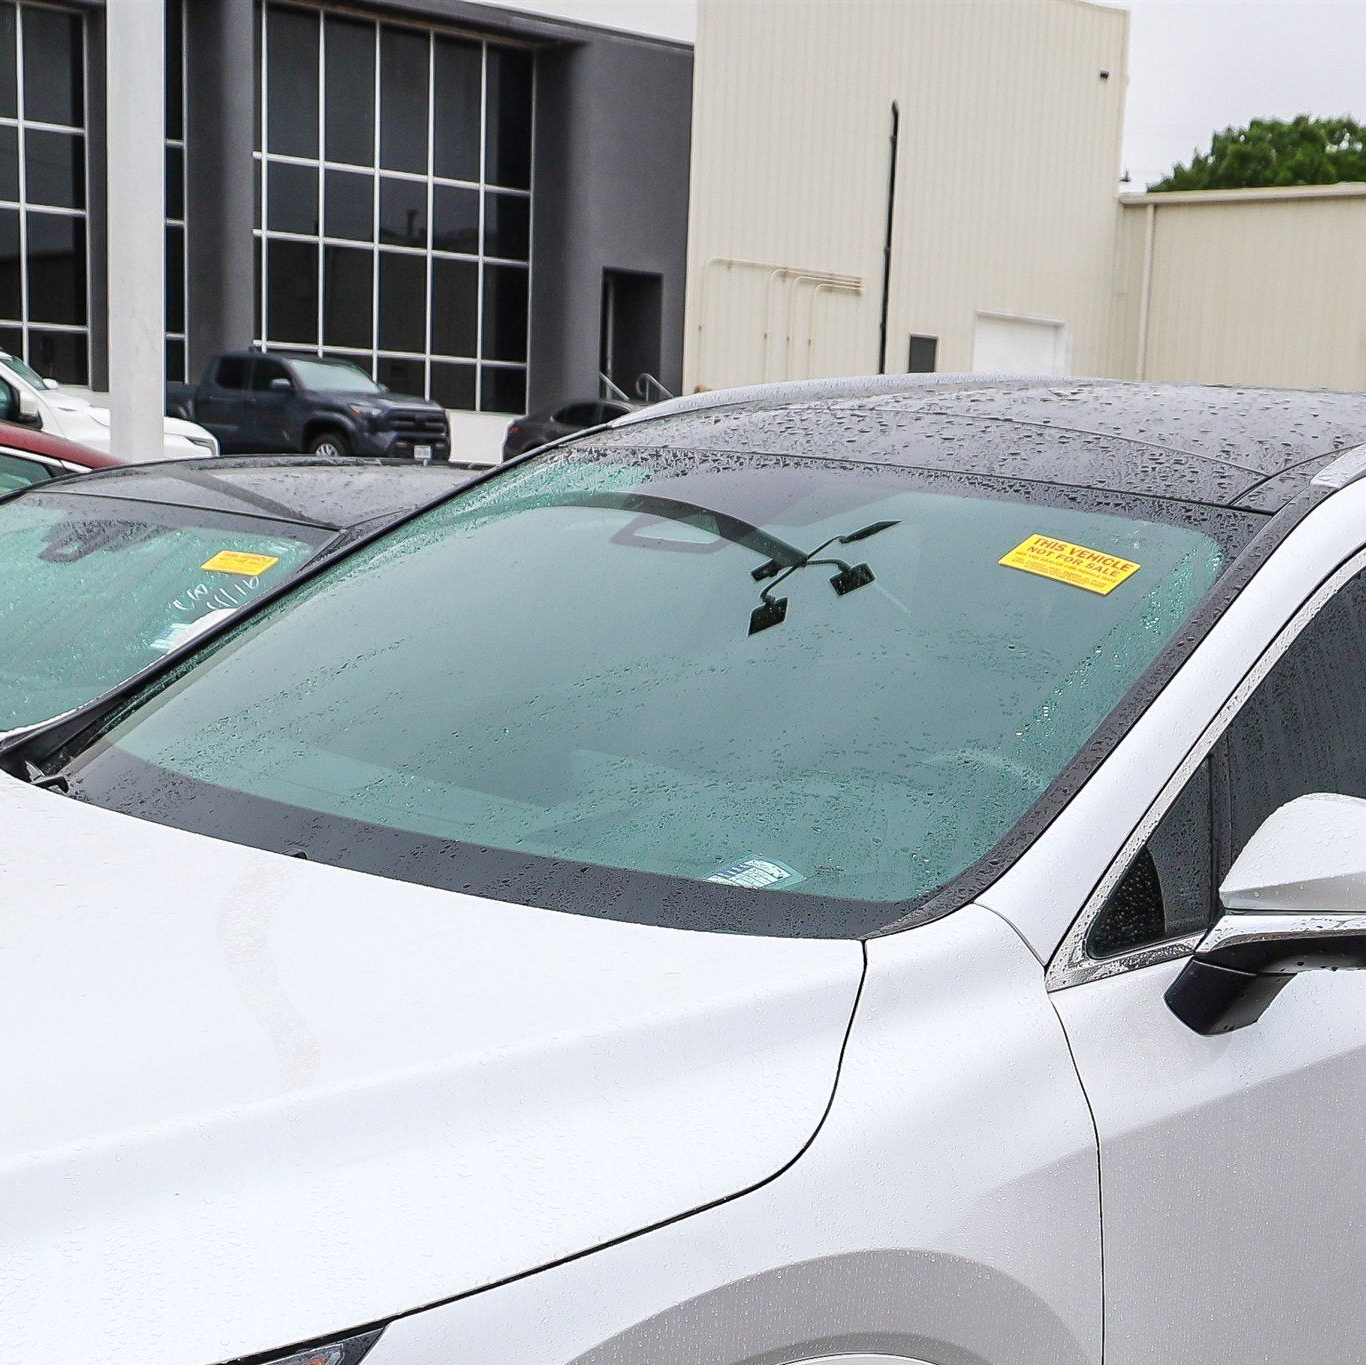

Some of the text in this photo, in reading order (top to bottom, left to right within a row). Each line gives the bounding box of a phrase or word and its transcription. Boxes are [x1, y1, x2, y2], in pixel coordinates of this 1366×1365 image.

[1027, 546, 1120, 577] NOT FOR SALE
[1034, 538, 1067, 551] THIS
[1069, 547, 1134, 572] VEHICLE
